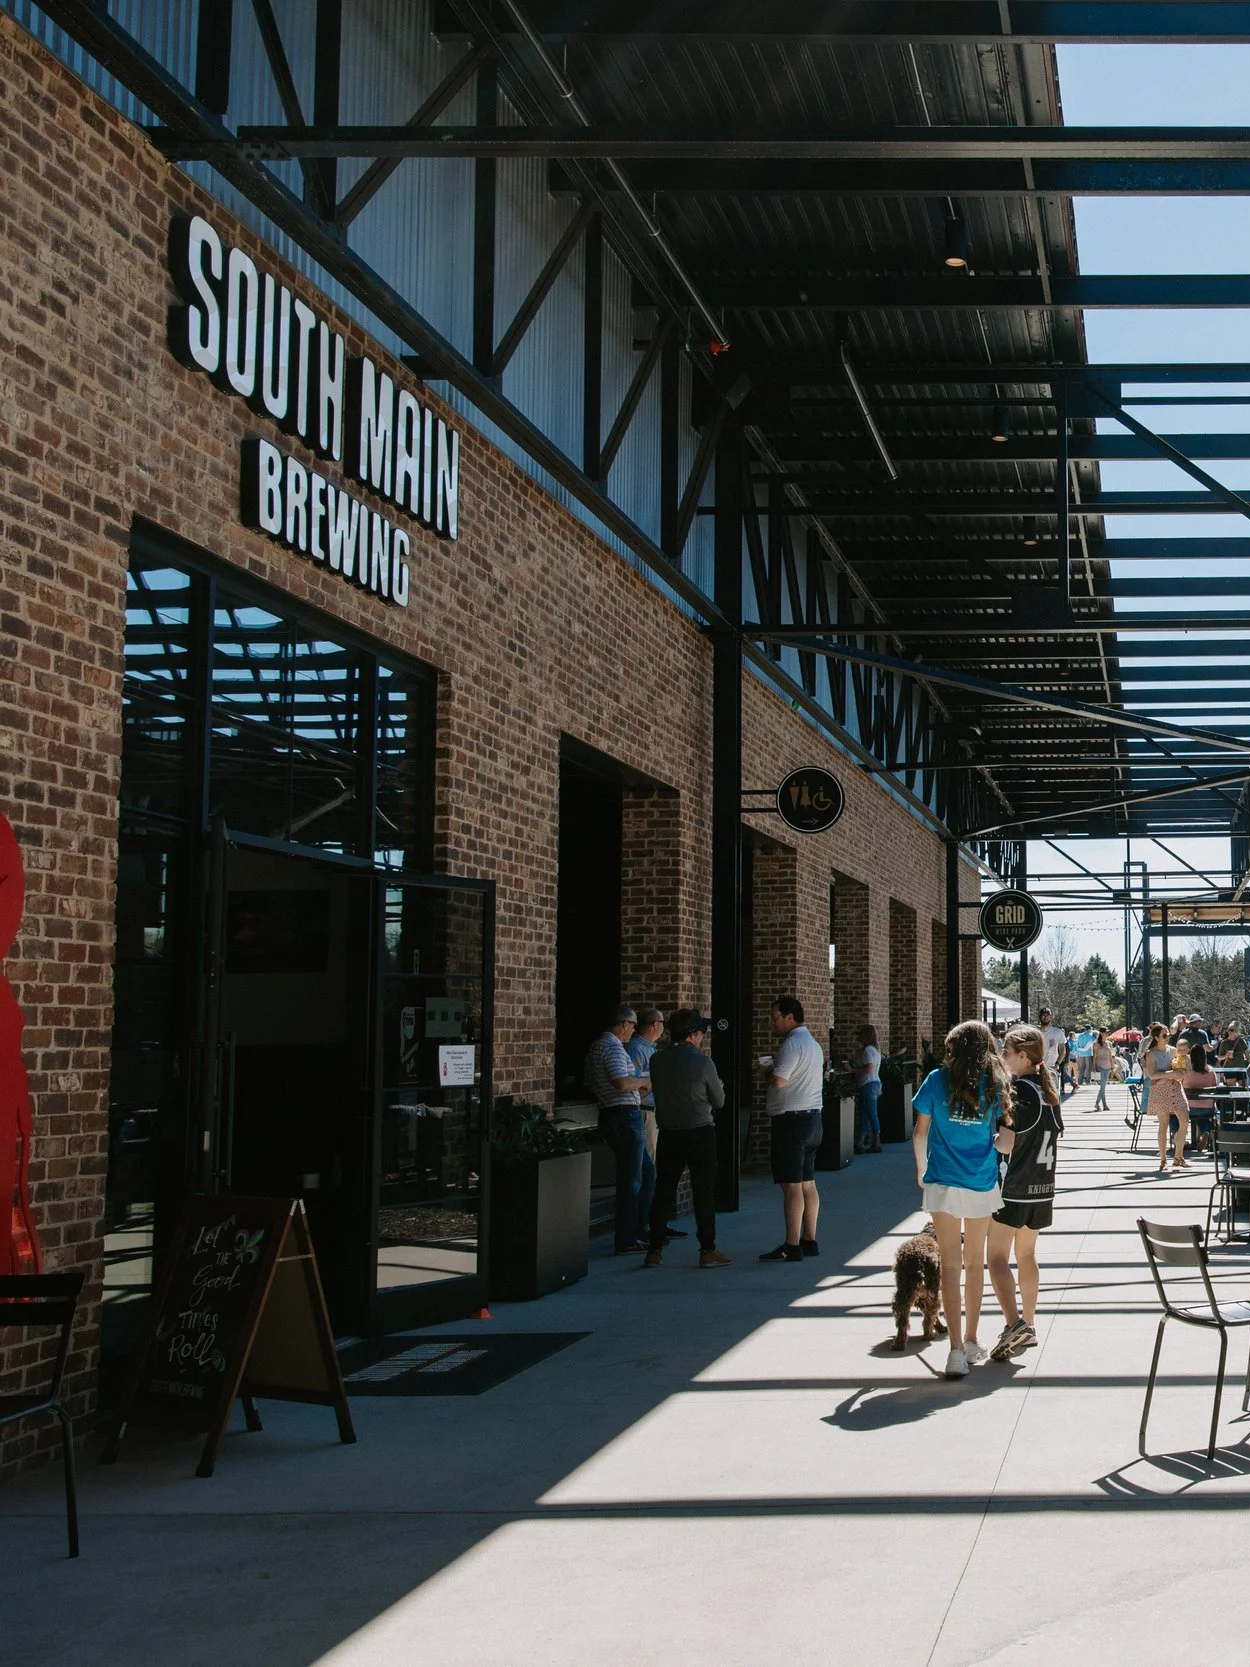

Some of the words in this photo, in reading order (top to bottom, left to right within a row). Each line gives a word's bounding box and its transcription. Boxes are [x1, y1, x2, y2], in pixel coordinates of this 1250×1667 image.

[189, 216, 345, 461] SOUTH
[359, 356, 459, 541] MAIN
[259, 438, 411, 607] BREWING
[995, 905, 1025, 924] GRID
[1036, 1130, 1055, 1171] 4
[192, 1225, 222, 1255] Let
[215, 1252, 232, 1265] THE
[189, 1264, 241, 1307] Good
[168, 1332, 216, 1366] Roll
